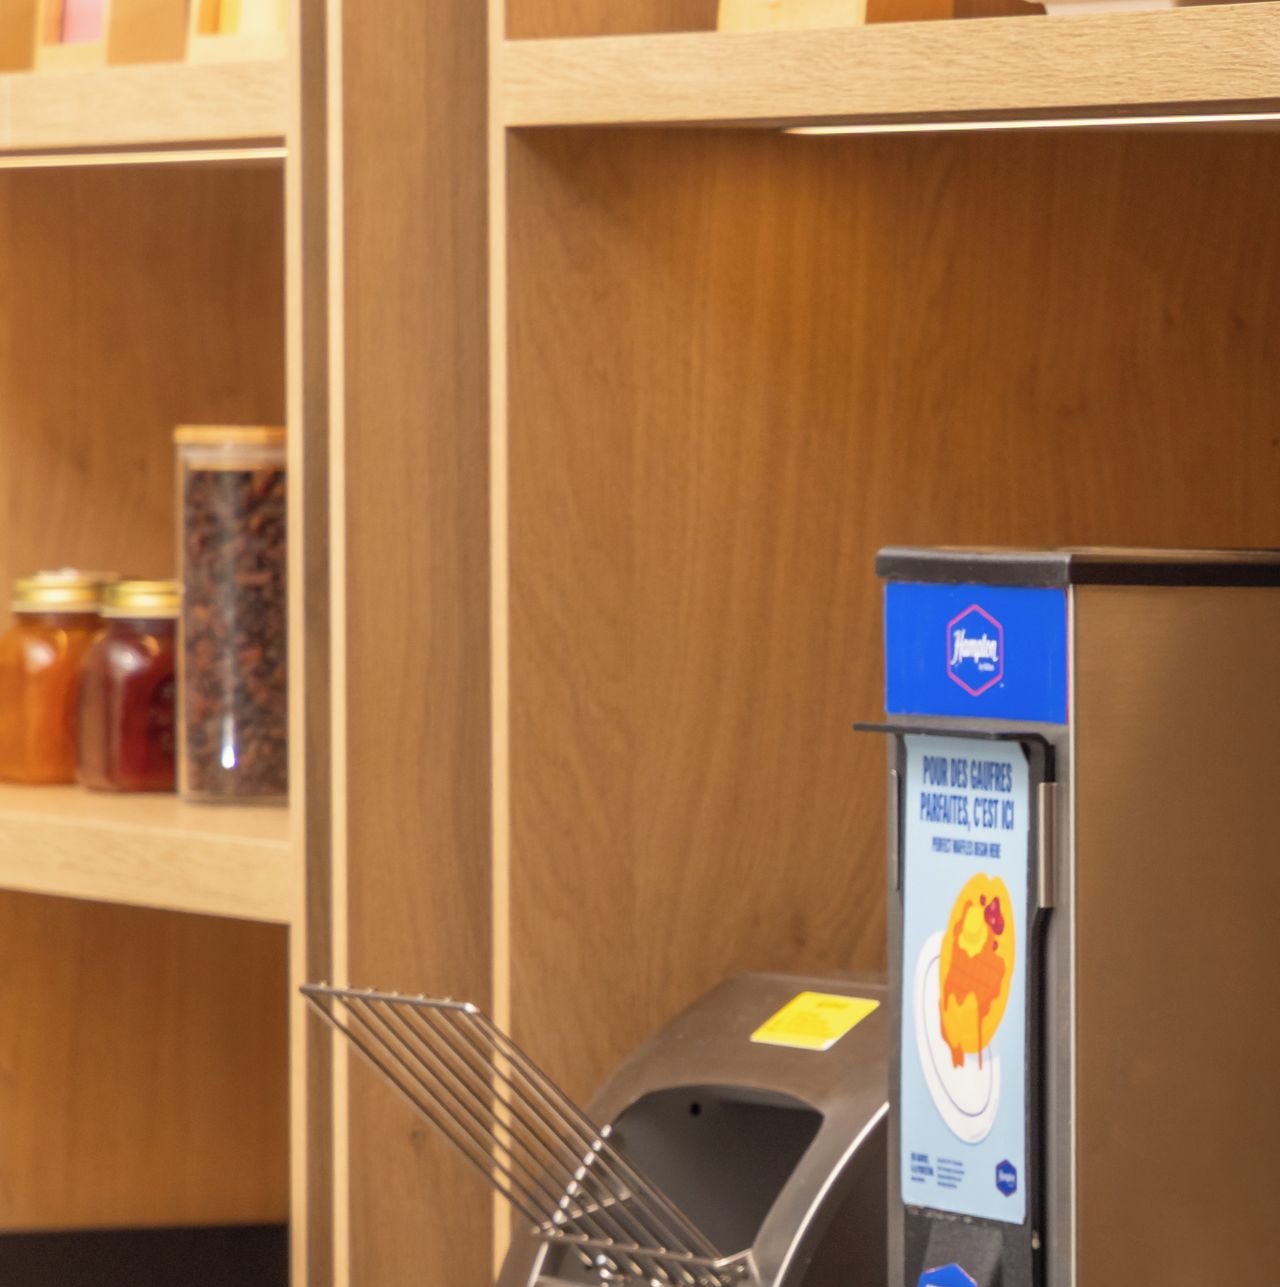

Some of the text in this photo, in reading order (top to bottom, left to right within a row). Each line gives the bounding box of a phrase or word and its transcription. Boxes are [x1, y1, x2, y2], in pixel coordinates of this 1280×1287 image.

[922, 755, 1012, 793] POUR DES GAUFRES
[920, 792, 1015, 832] PARFAITES, C'EST ICI
